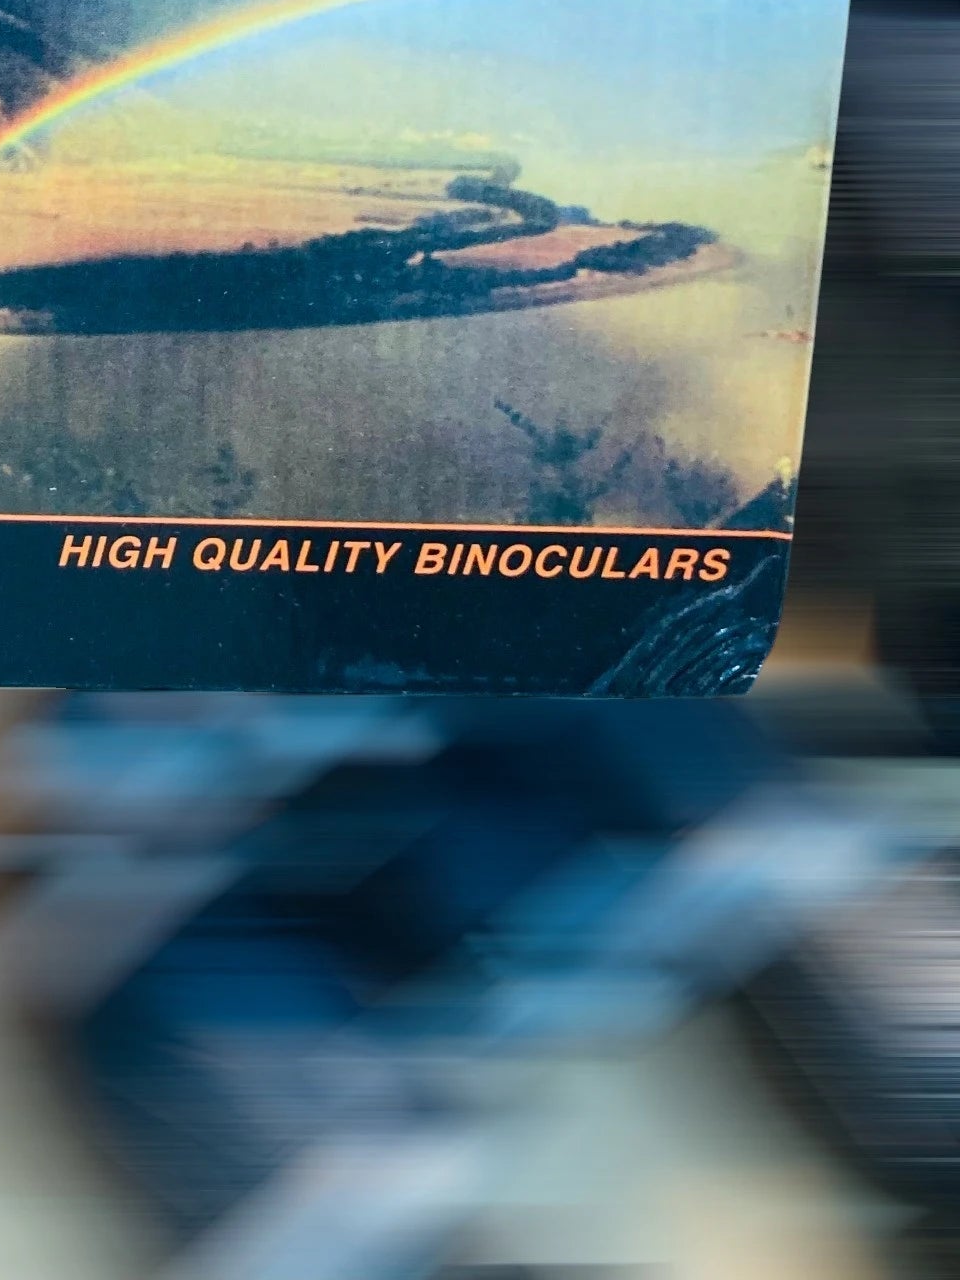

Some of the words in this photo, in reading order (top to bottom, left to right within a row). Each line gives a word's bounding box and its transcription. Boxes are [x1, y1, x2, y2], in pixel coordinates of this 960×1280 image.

[58, 535, 177, 570] HIGH
[192, 537, 401, 575] QUALITY
[413, 543, 731, 582] BINOCULARS
